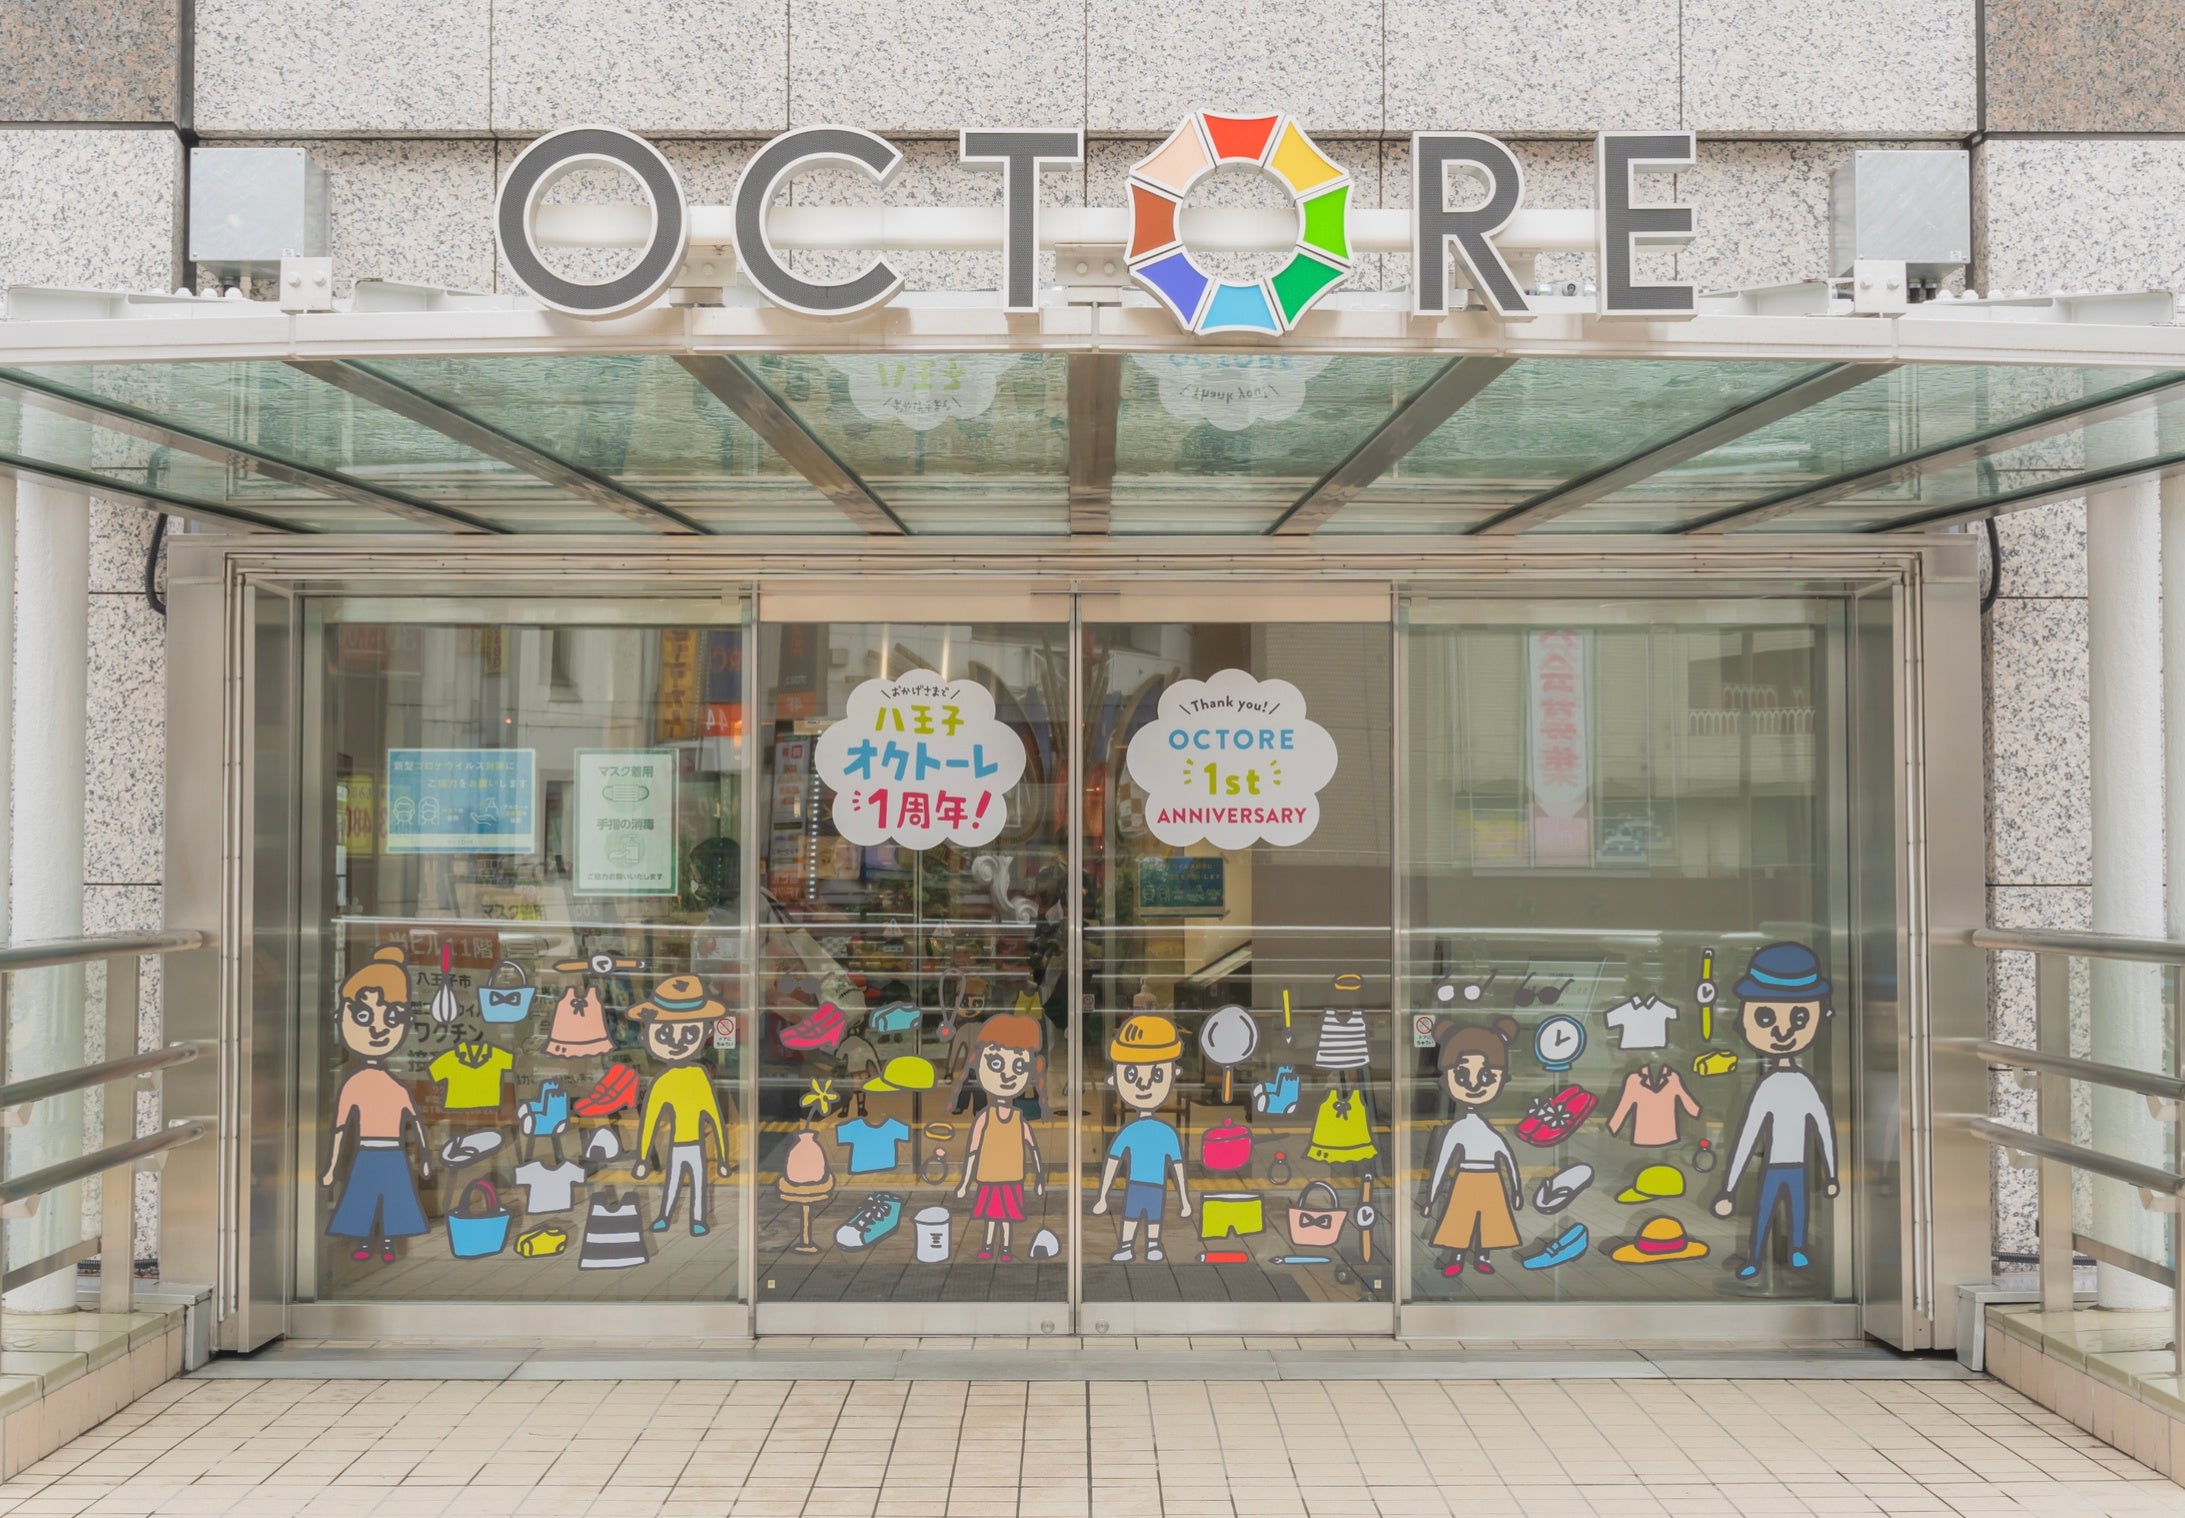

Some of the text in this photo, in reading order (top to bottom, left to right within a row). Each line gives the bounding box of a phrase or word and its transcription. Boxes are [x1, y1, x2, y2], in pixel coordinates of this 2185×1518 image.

[494, 112, 1698, 339] OCTORE
[891, 684, 950, 698] おかげさまで
[1190, 695, 1268, 713] Thank you!
[874, 704, 965, 737] 八王子
[1168, 728, 1295, 750] OCTORE
[843, 738, 999, 782] オクトーレ
[598, 765, 654, 778] マスク着用
[1203, 761, 1261, 796] 1st
[868, 788, 992, 830] 1周年!
[1156, 807, 1308, 824] ANNIVERSARY
[596, 818, 655, 831] 手指の消毒
[413, 1022, 484, 1044] ワクチン
